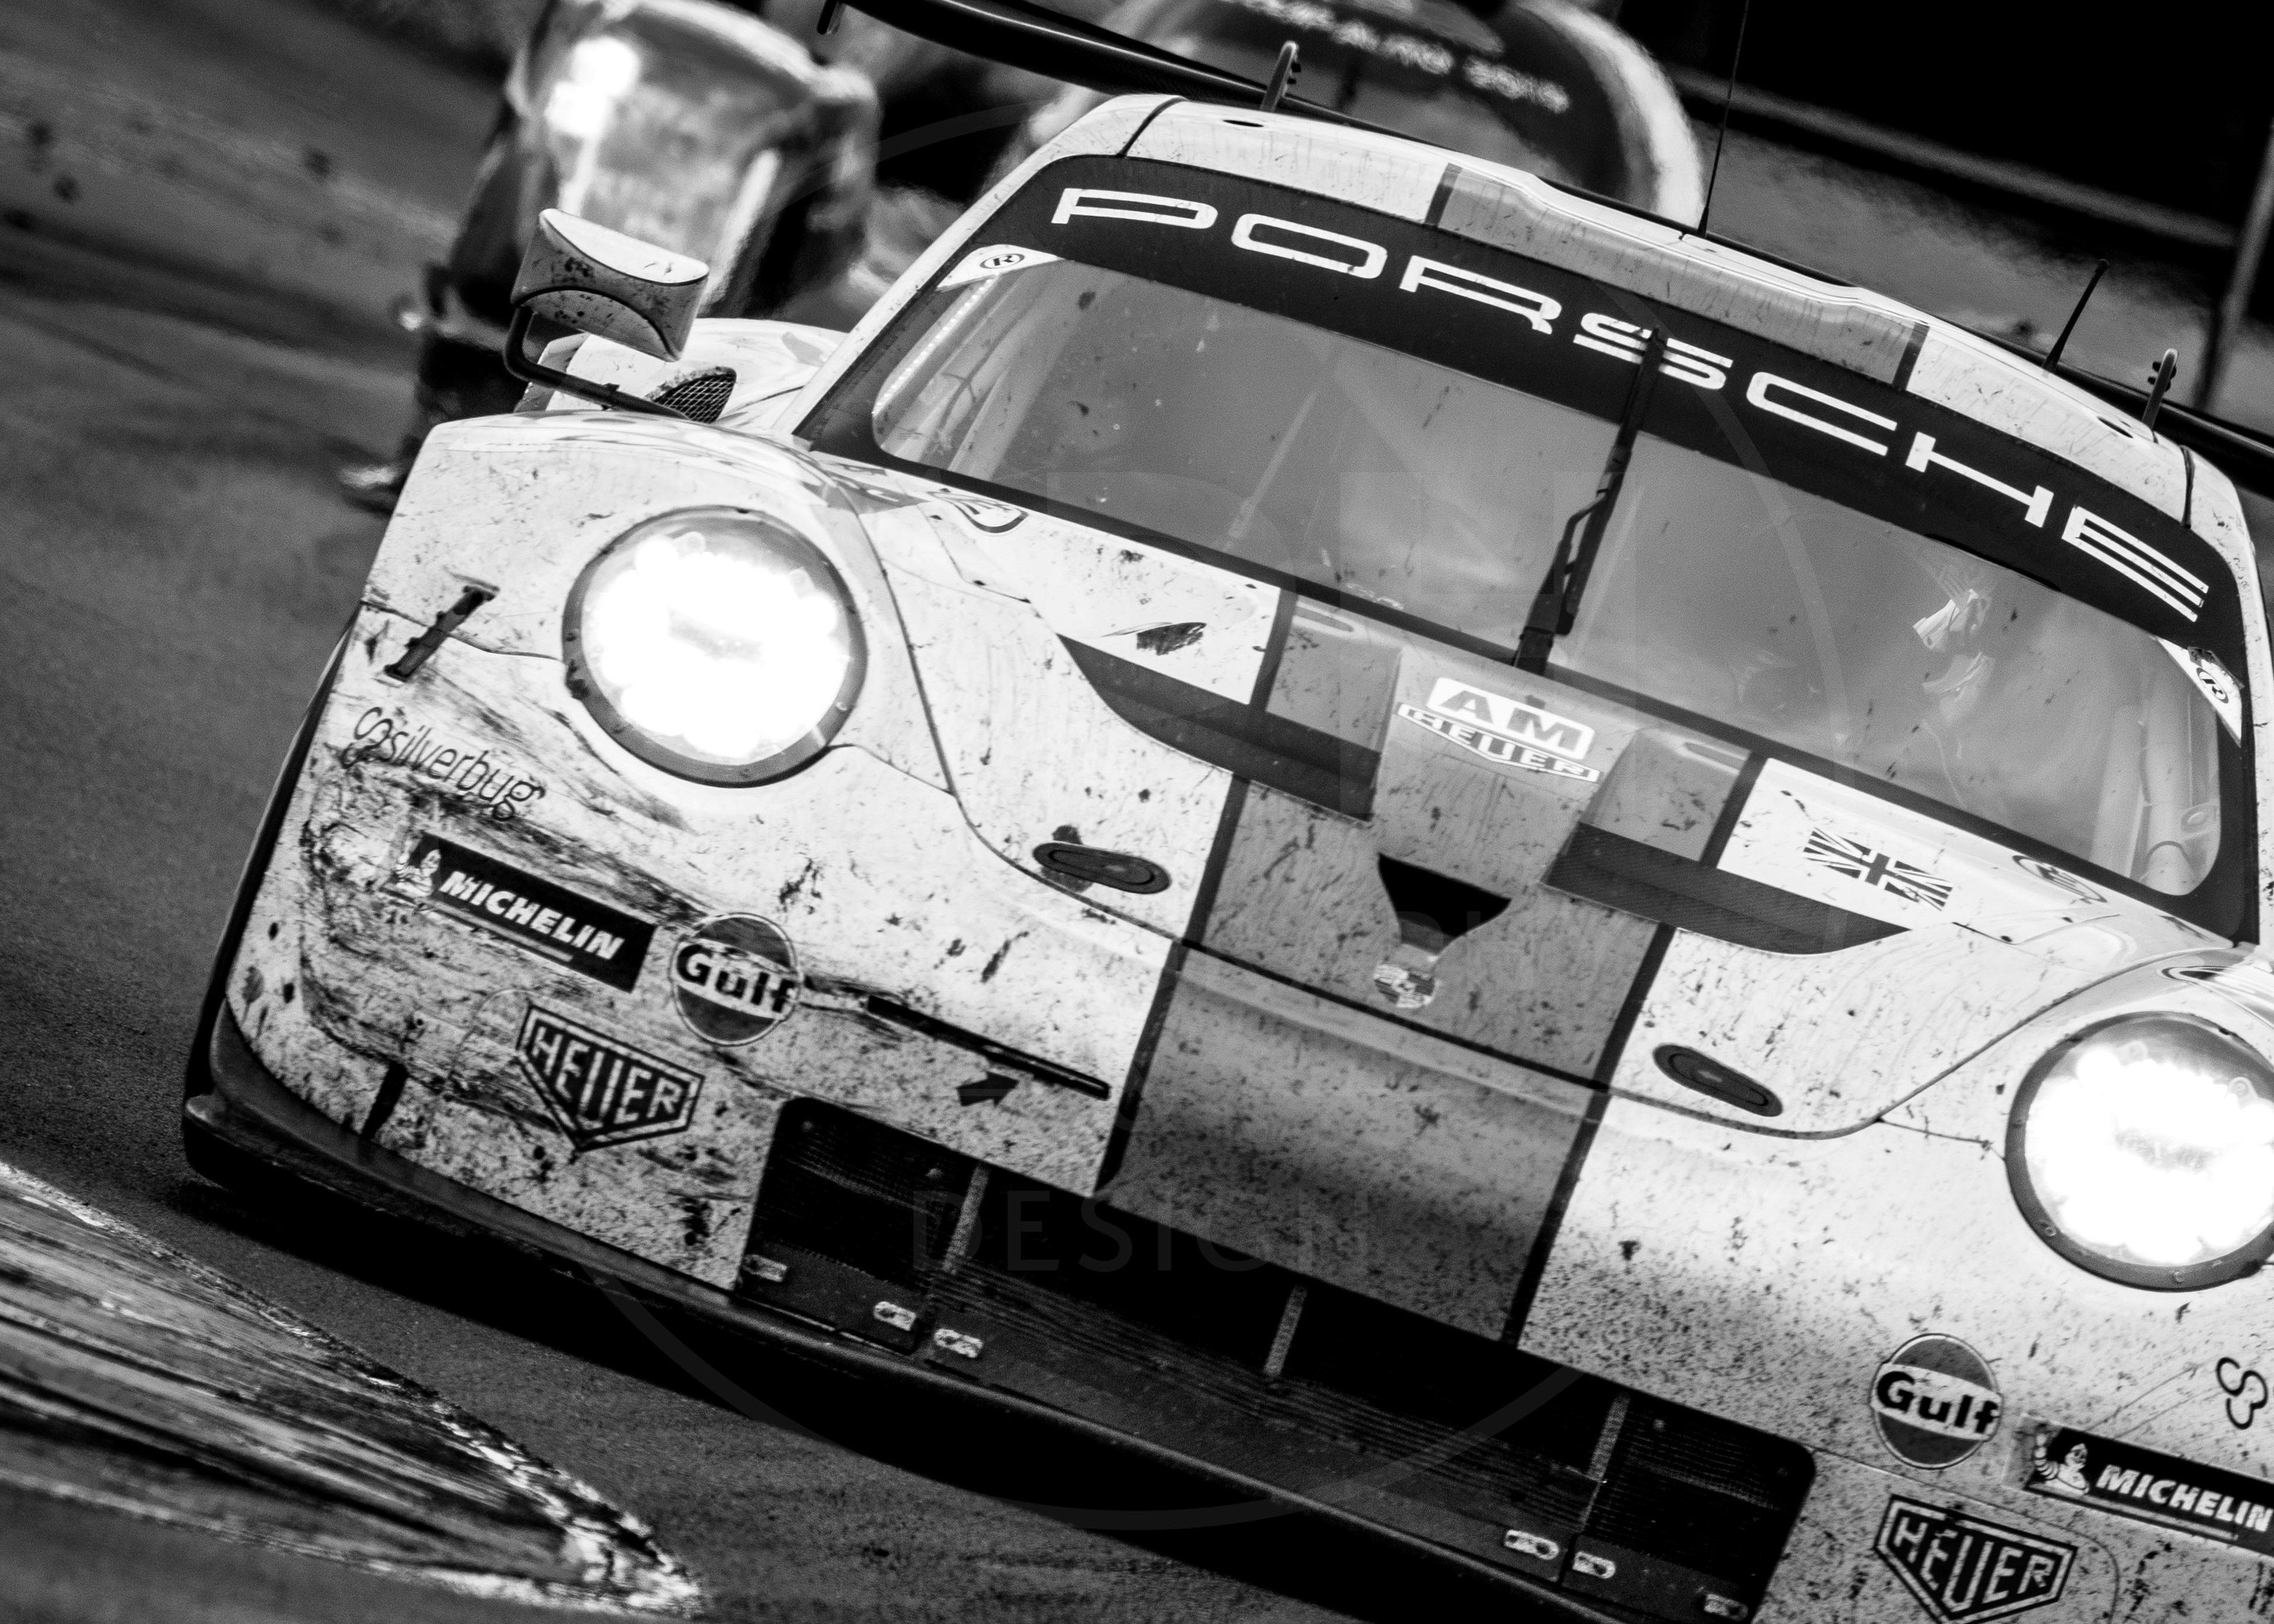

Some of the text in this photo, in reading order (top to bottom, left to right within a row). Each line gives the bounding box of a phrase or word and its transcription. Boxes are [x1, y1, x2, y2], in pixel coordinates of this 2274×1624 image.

[1051, 188, 2209, 622] PORSCHE
[1412, 711, 1587, 776] HEUER
[1439, 690, 1584, 752] AM
[439, 870, 625, 961] MICHELIN
[676, 944, 796, 1014] Gulf
[531, 1026, 685, 1129] HEUER
[1876, 1370, 2000, 1435] Gulf
[2097, 1464, 2274, 1533] MICHELIN
[1894, 1516, 2055, 1615] HEUER
